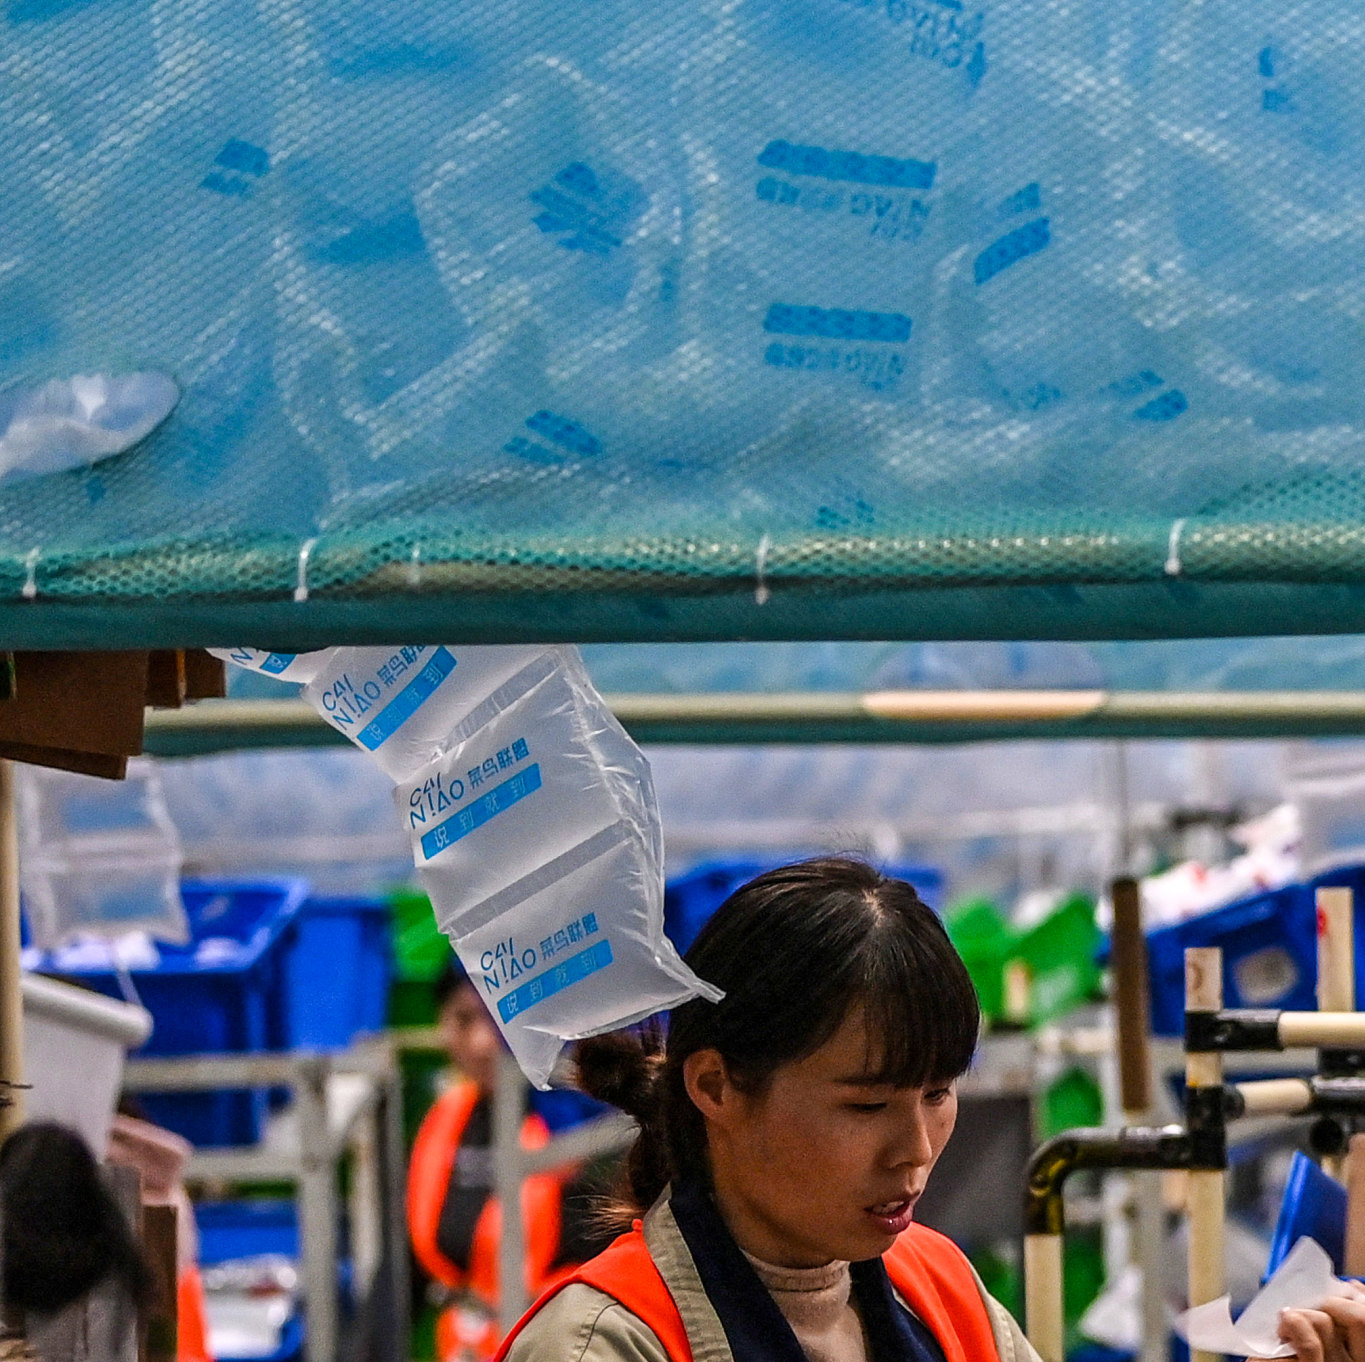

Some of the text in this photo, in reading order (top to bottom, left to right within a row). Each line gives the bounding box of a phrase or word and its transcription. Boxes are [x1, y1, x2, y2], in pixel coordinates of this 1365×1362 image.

[467, 737, 530, 789] 菜鸟联盟
[540, 912, 599, 961] 菜鸟联盟
